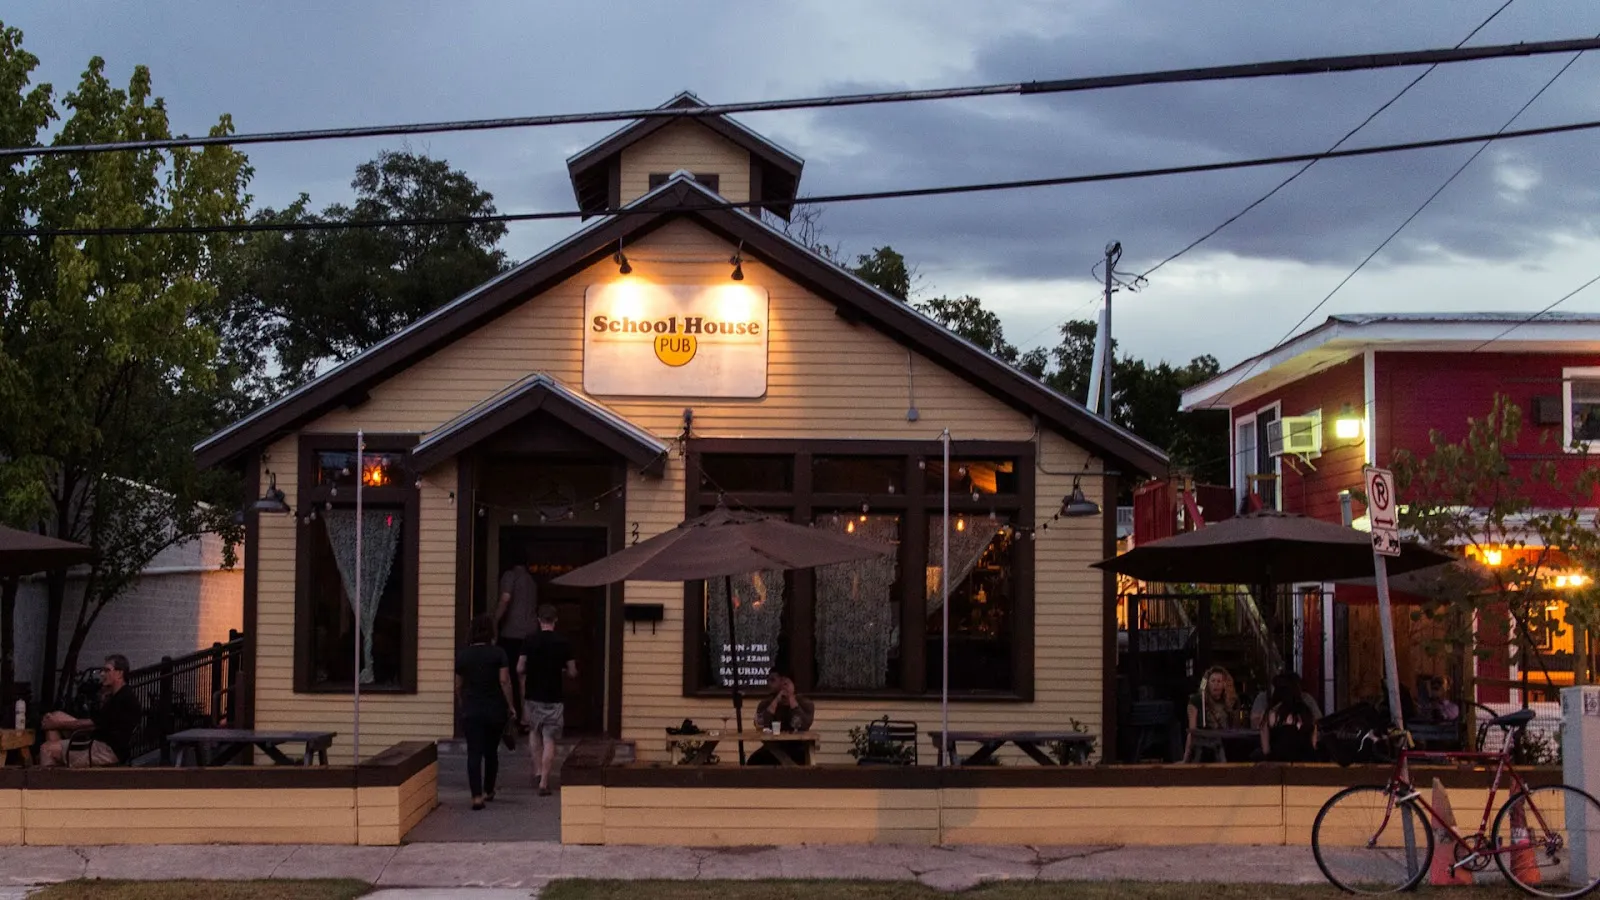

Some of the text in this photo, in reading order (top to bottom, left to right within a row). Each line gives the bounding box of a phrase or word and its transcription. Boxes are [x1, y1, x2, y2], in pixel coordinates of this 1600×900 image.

[593, 316, 760, 335] School House
[660, 338, 691, 353] PUB
[719, 667, 771, 675] SAURDAY
